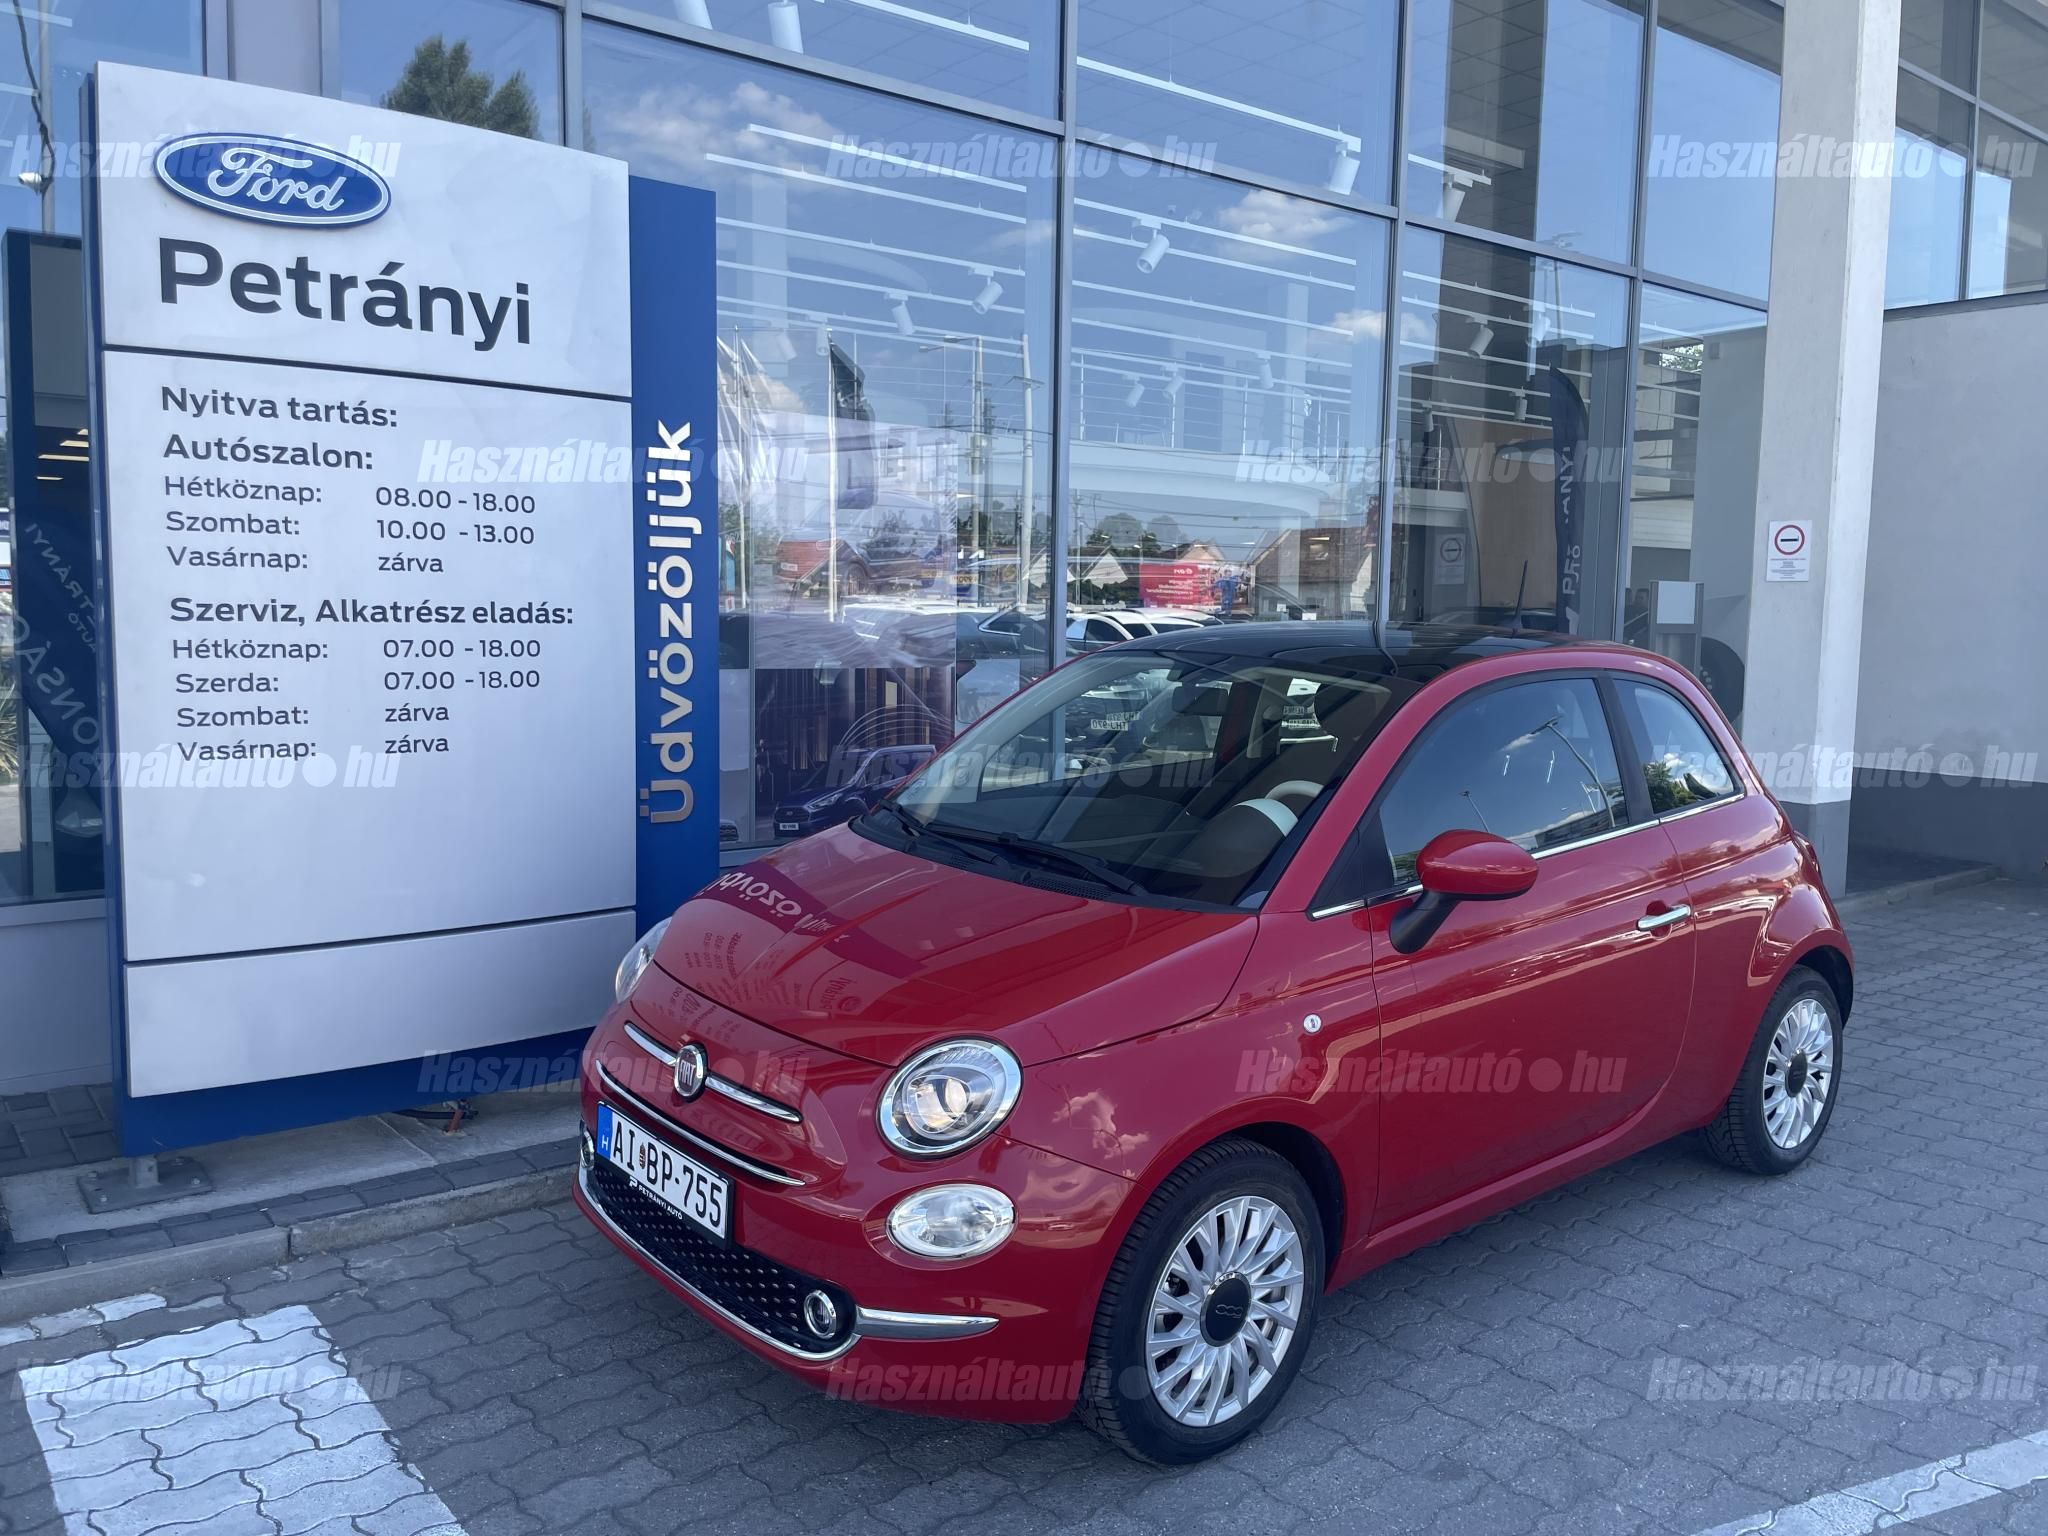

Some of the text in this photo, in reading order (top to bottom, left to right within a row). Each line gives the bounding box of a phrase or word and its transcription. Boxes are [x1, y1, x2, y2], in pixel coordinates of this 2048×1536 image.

[207, 147, 345, 212] Ford
[159, 236, 531, 353] Petrányi
[161, 386, 397, 428] Nyitva tartás:
[163, 433, 373, 470] Autószalon:
[166, 545, 444, 573] Vasárnap: zárva
[170, 597, 573, 627] Szerviz, Alkatrész eladás:
[640, 419, 703, 824] Üdvözöljük
[176, 702, 450, 728] Szombat: zárva
[177, 734, 450, 762] Vasárnap: zárva
[679, 1059, 697, 1087] FIAT
[601, 1134, 609, 1152] H
